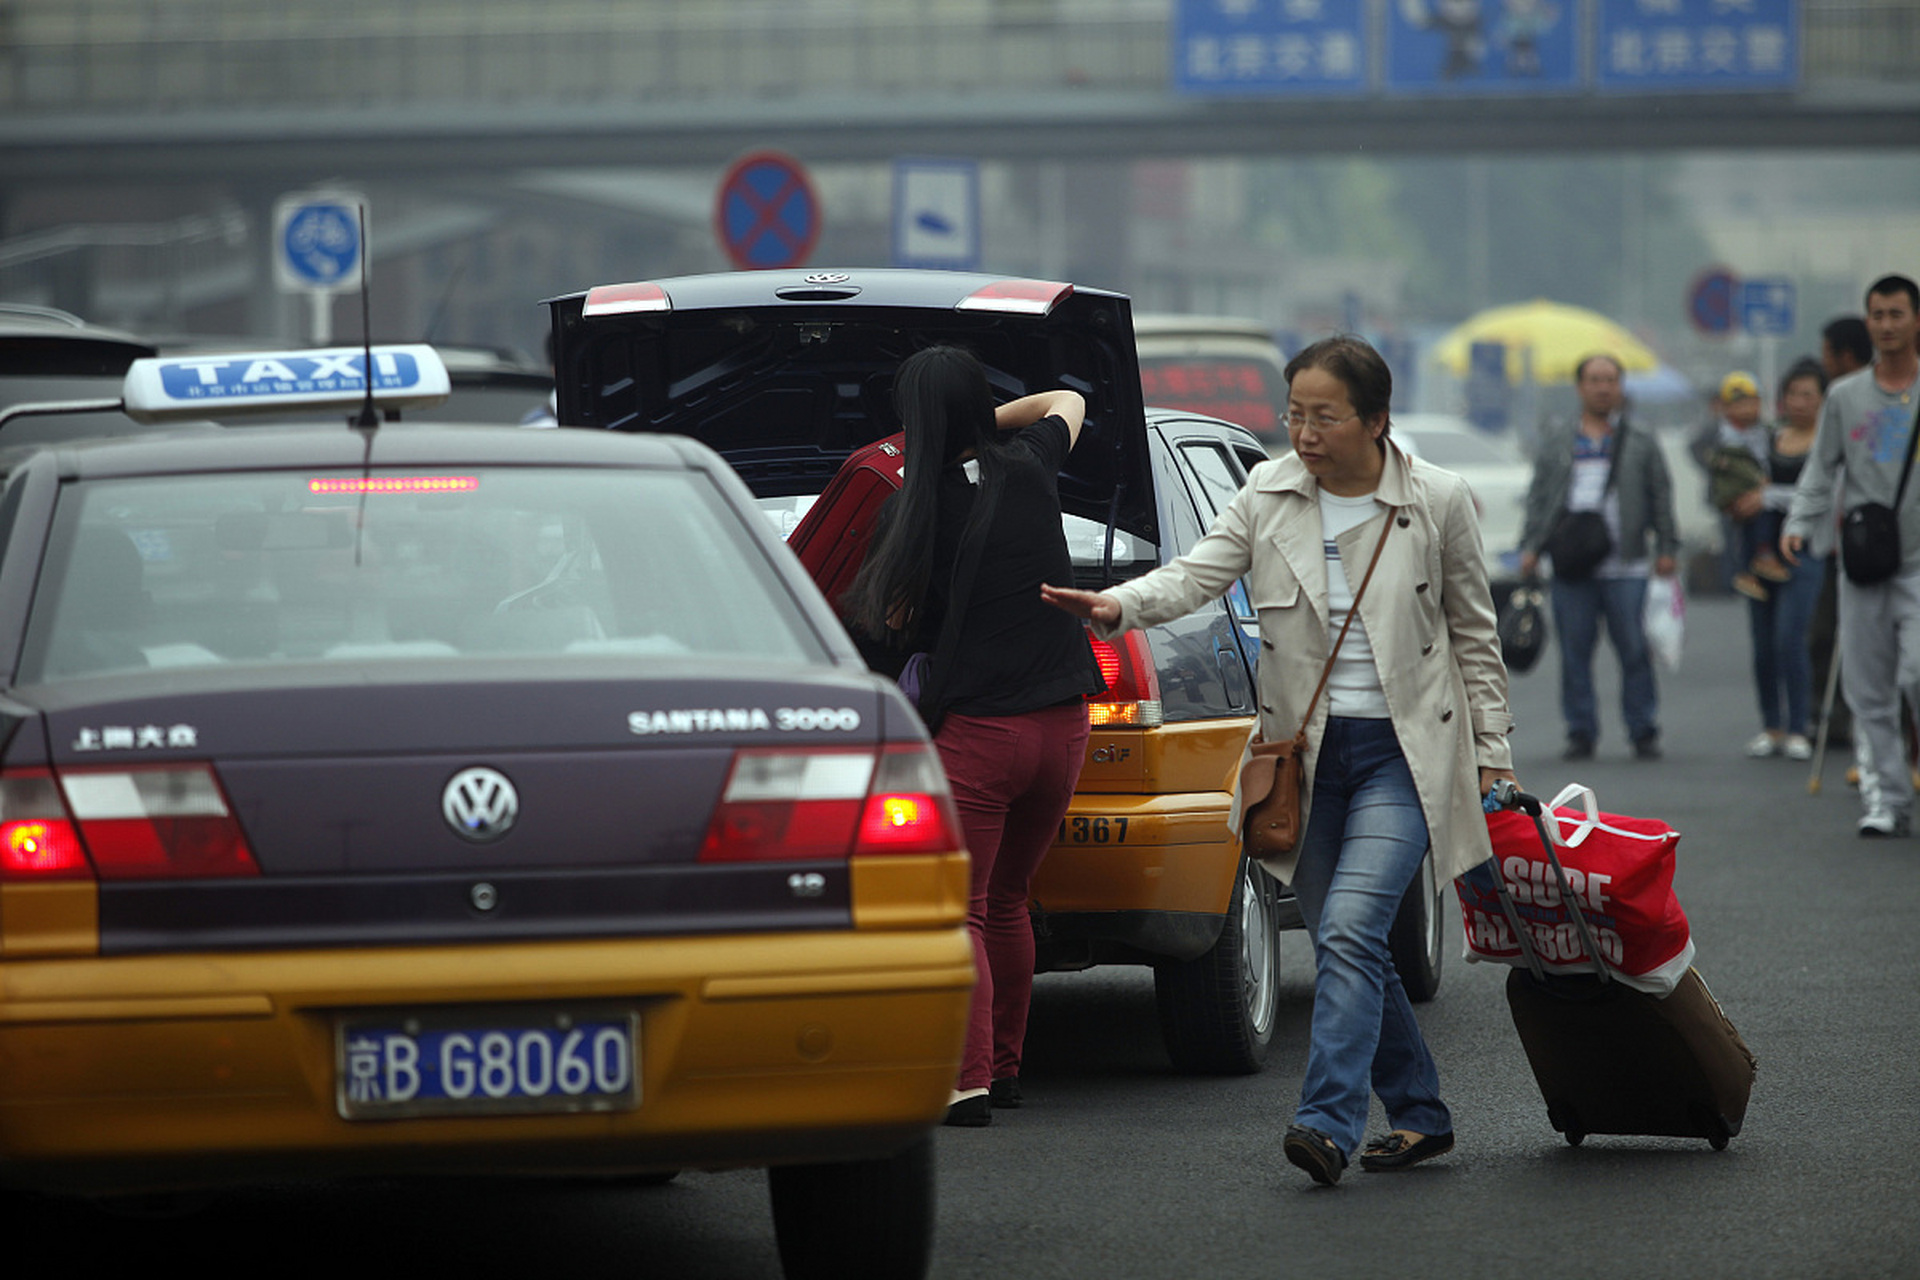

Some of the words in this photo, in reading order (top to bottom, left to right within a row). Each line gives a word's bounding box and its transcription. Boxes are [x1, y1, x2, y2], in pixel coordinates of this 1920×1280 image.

[178, 354, 398, 385] TAXI
[627, 707, 771, 735] SANTANA
[774, 706, 861, 731] 3000
[1503, 855, 1612, 913] SURF
[440, 1027, 630, 1099] G8060
